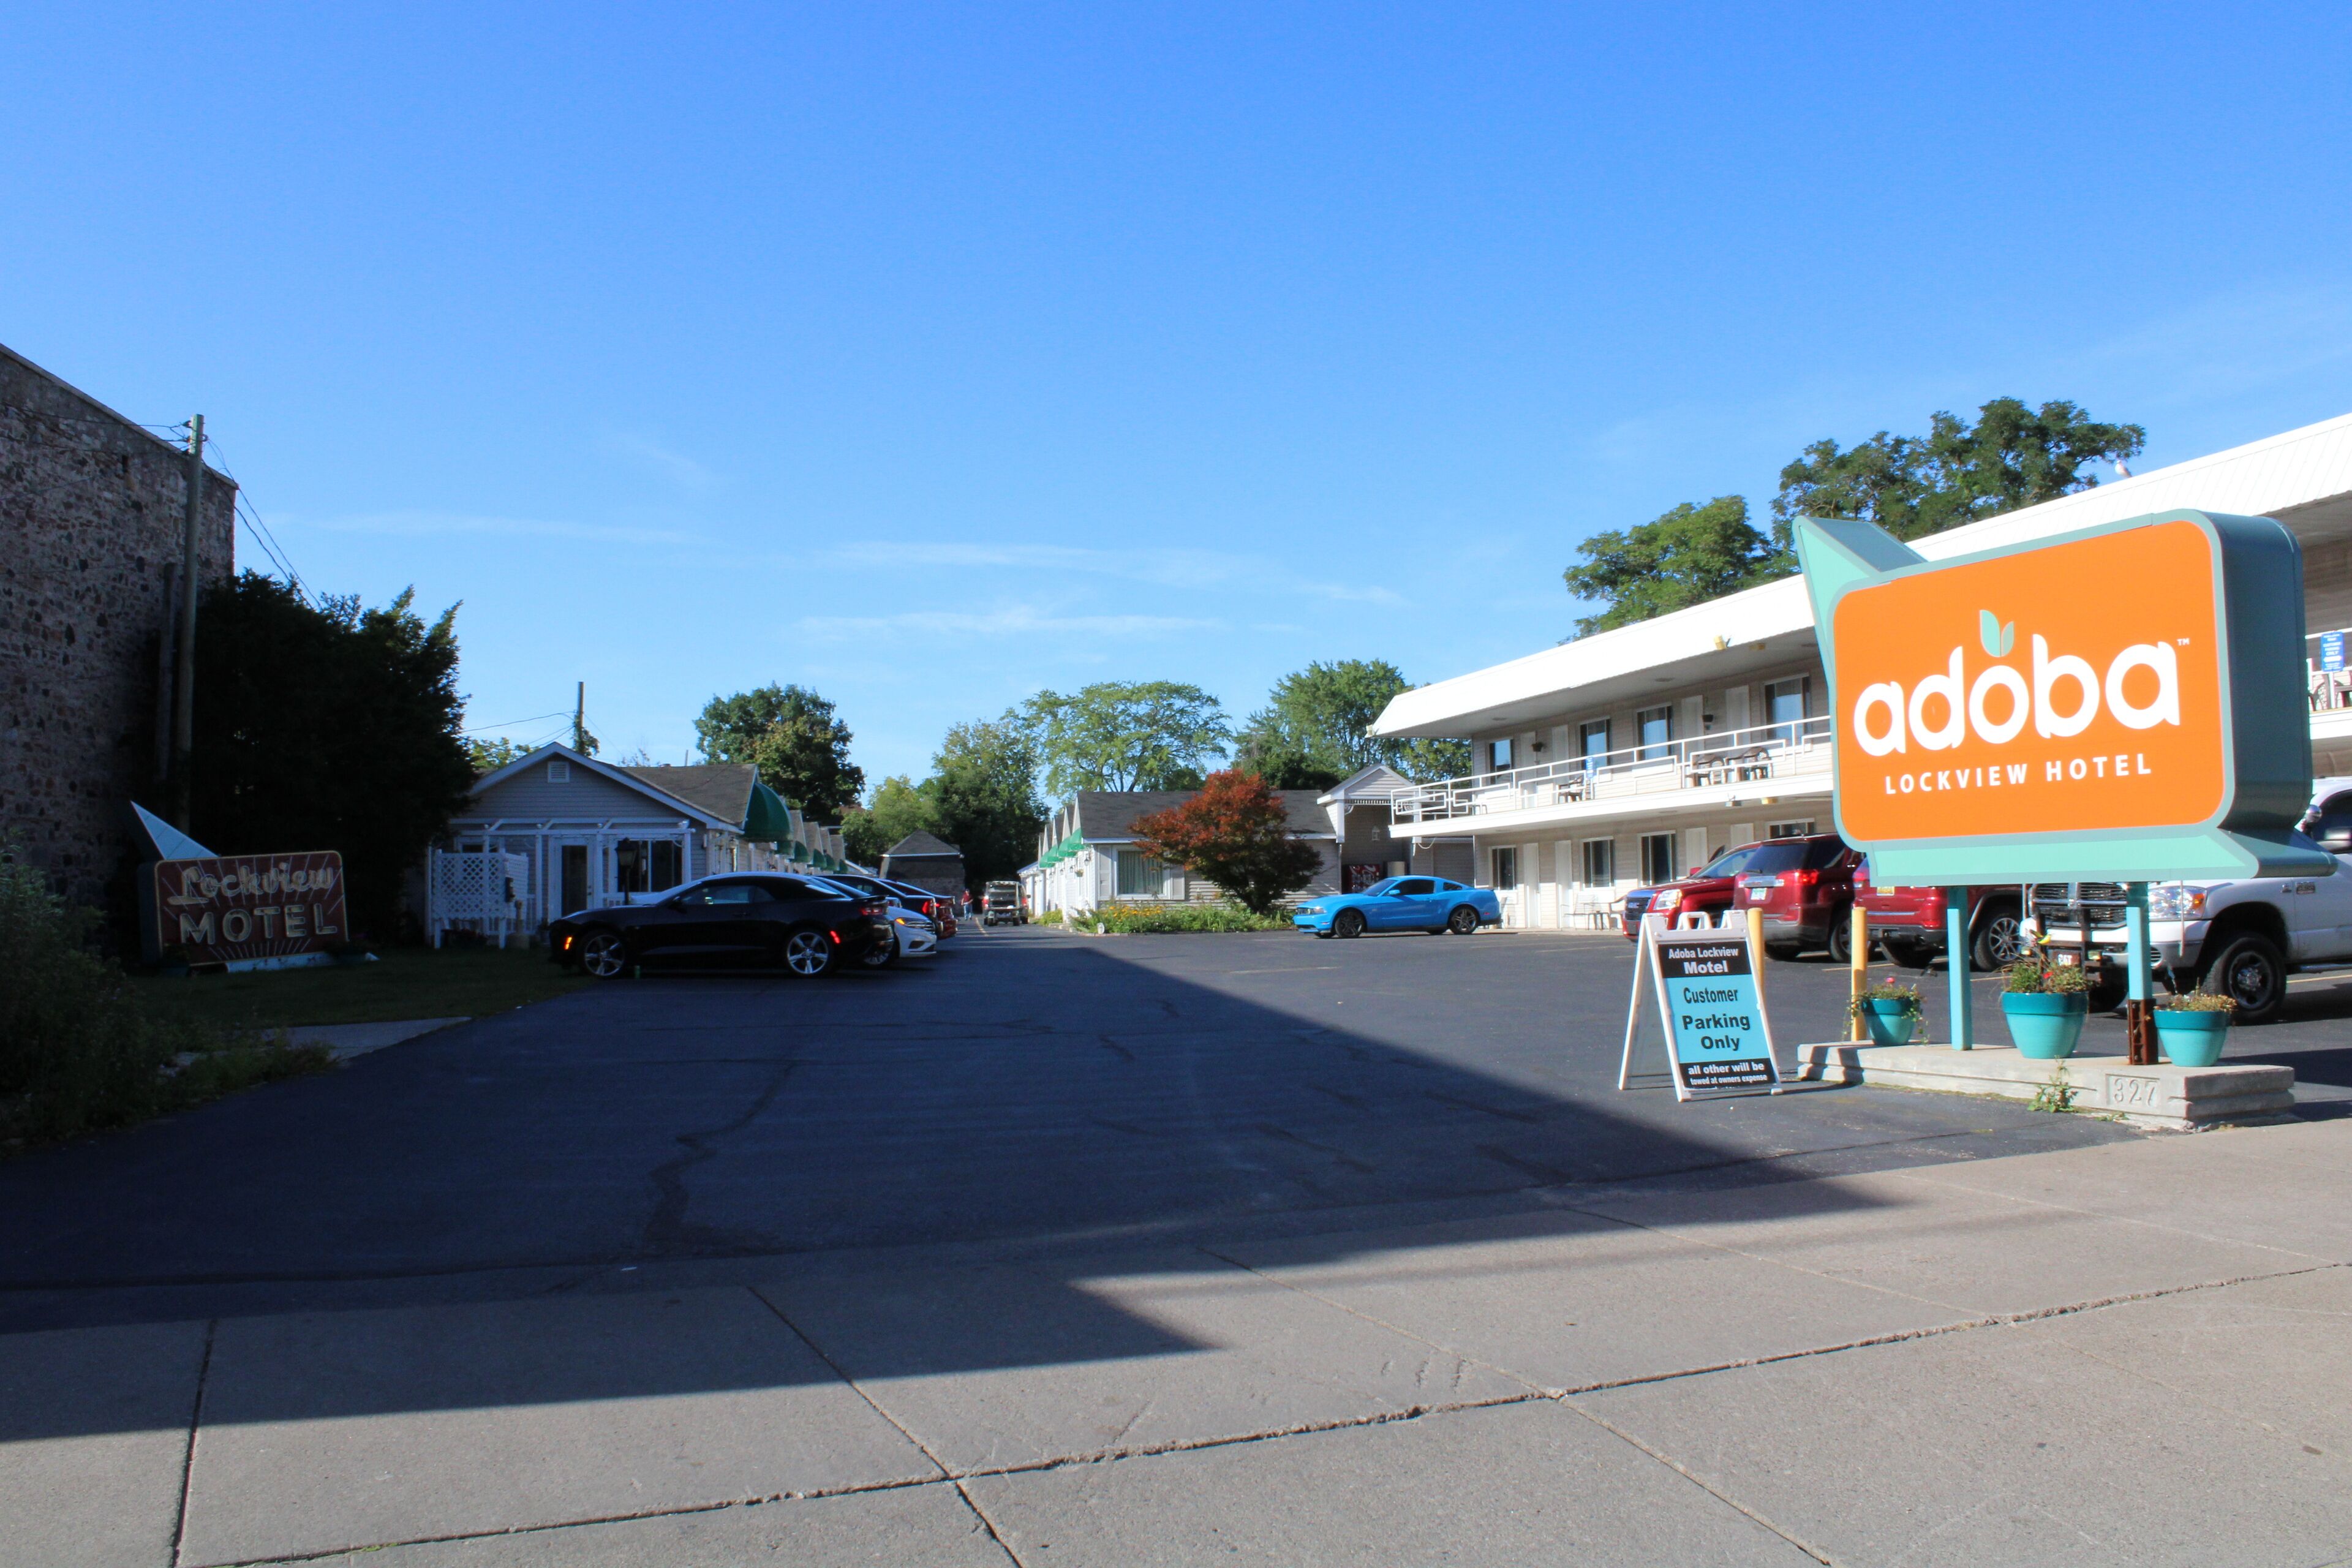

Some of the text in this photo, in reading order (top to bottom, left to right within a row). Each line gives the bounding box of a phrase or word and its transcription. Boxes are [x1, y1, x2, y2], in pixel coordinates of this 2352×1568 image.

[1852, 633, 2180, 757] adoba
[1885, 753, 2152, 794] LOCKVIEW HOTEL
[167, 862, 334, 905] Lockview
[179, 903, 338, 945] MOTEL
[1668, 946, 1739, 959] Adoba Lockview
[1684, 960, 1729, 974] Motel
[1683, 987, 1738, 1004] Customer
[1682, 1013, 1751, 1031] Parking
[1700, 1035, 1740, 1051] Only
[1687, 1061, 1765, 1075] all other will be
[1690, 1076, 1710, 1085] towed
[1718, 1075, 1741, 1084] owners
[1741, 1073, 1768, 1083] expense
[2113, 1077, 2158, 1106] 327
